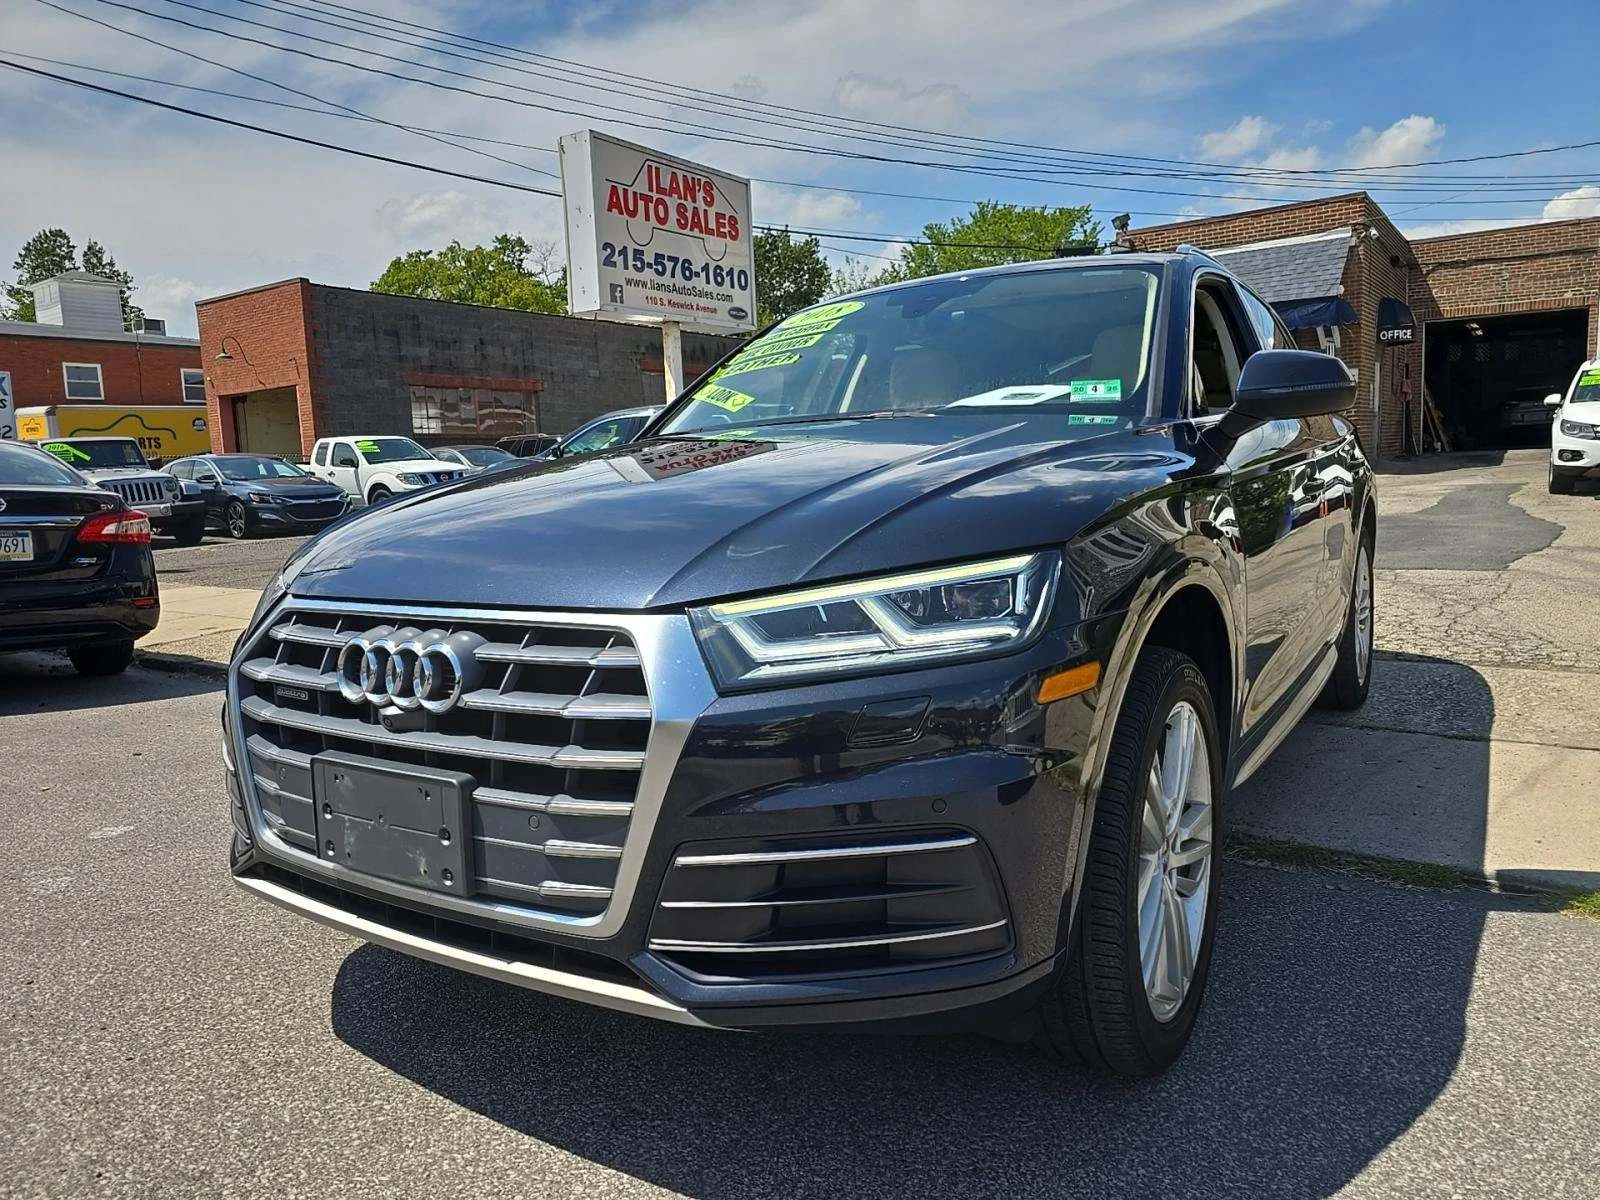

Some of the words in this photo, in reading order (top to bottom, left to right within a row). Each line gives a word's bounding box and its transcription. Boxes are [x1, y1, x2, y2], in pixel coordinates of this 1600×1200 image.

[647, 164, 715, 208] ILAN'S
[607, 184, 670, 226] AUTO
[675, 202, 741, 242] SALES
[601, 242, 750, 292] 215-576-1610
[645, 296, 658, 306] 110
[667, 299, 694, 311] Keswick
[695, 303, 718, 314] Avenue
[1379, 328, 1413, 341] OFFICE
[1091, 385, 1098, 393] 4
[0, 537, 26, 553] 691
